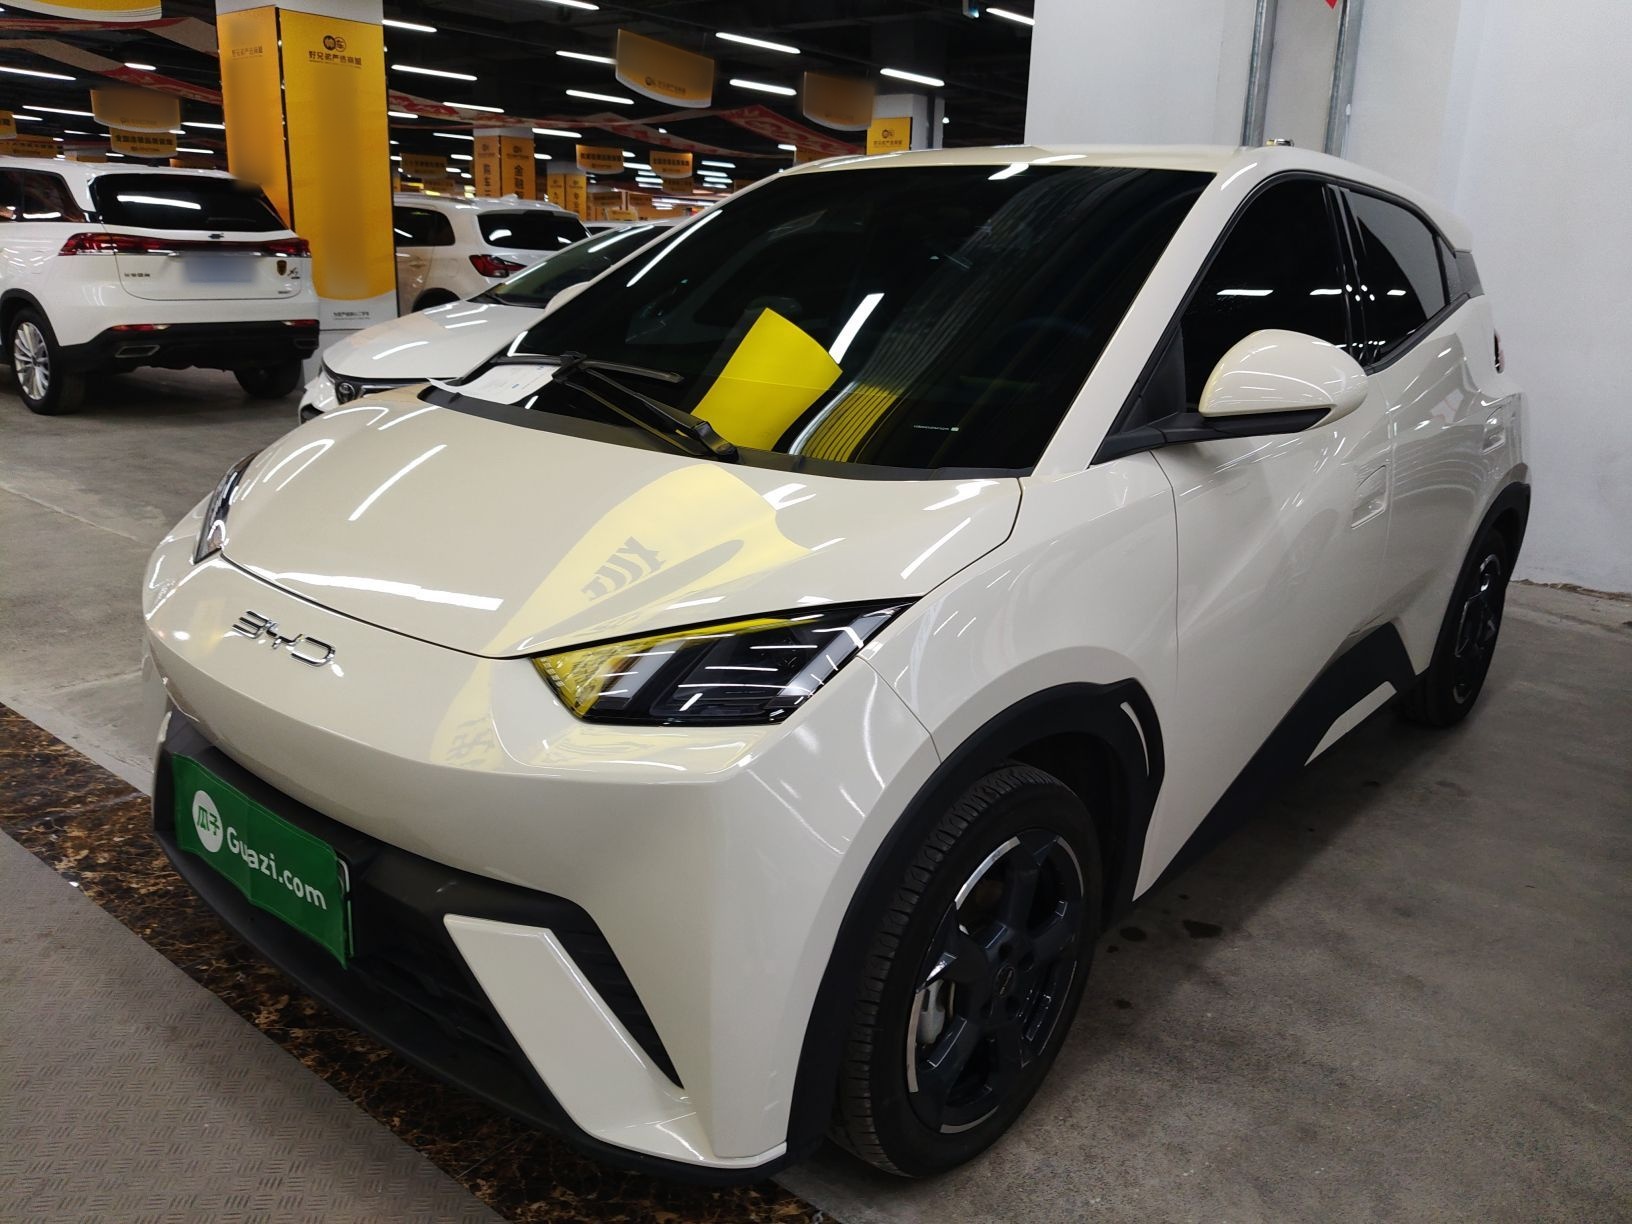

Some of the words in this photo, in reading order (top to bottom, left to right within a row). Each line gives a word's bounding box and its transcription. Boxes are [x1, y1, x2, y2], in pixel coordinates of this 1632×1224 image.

[231, 610, 336, 668] BYD
[196, 805, 220, 837] 瓜子
[227, 826, 327, 910] Guazi.com
